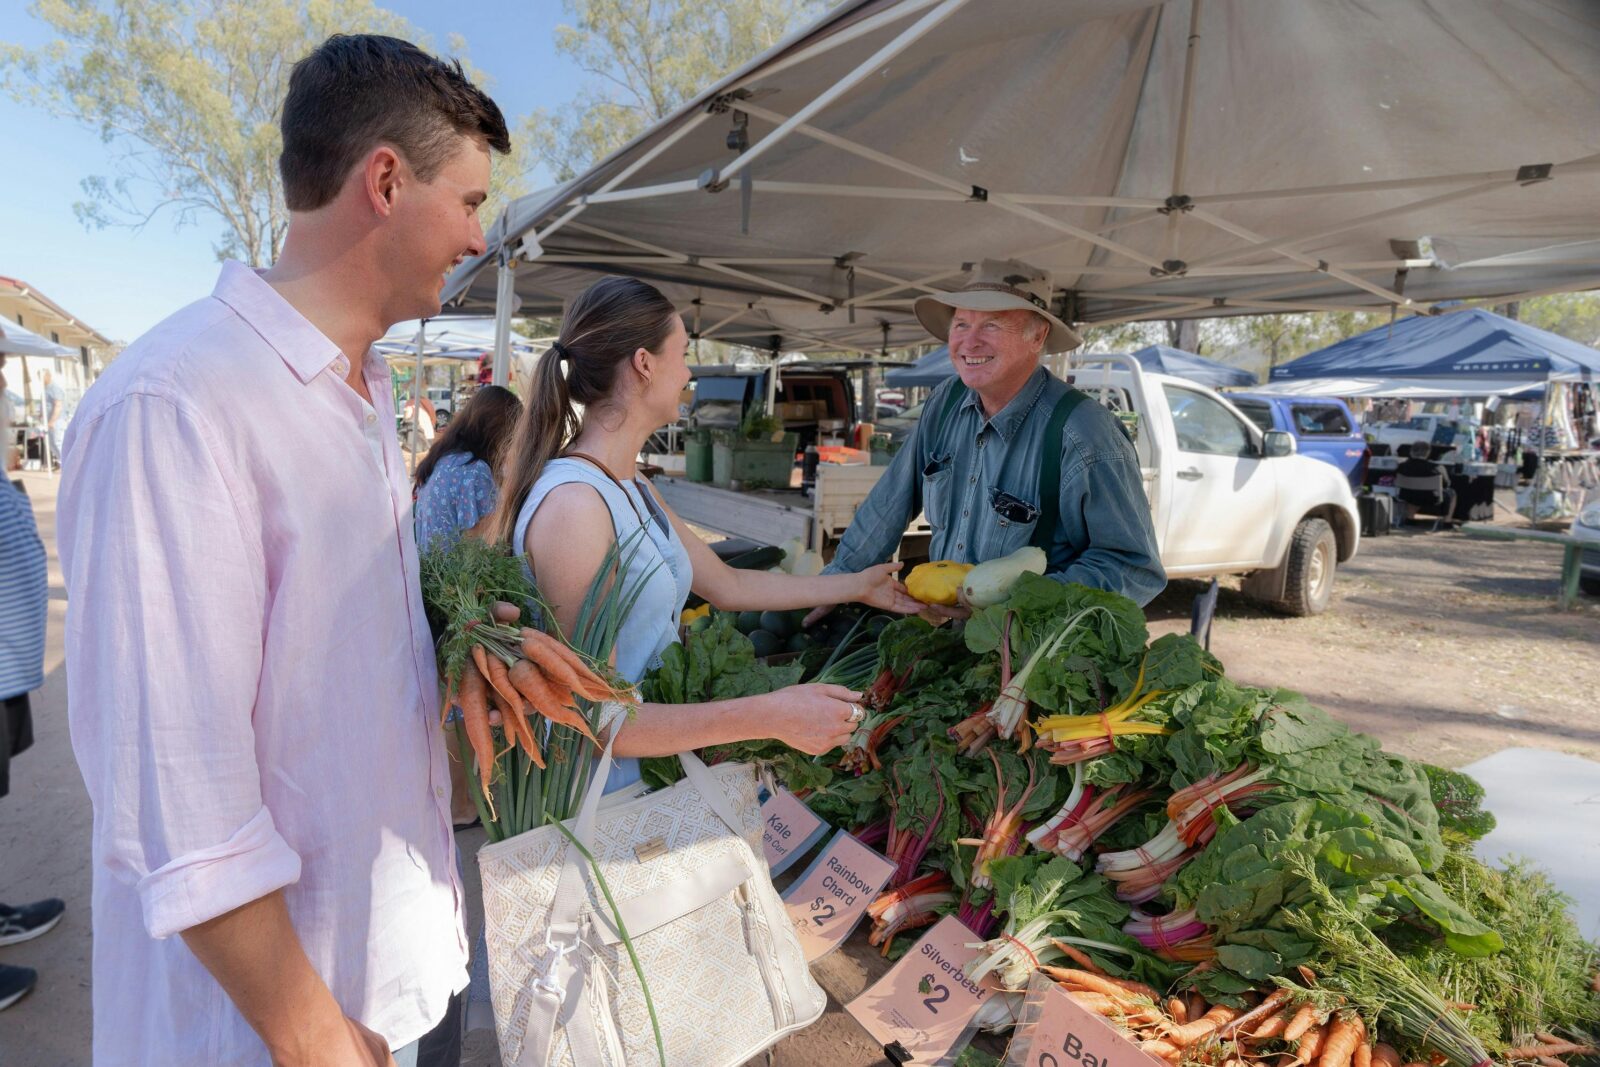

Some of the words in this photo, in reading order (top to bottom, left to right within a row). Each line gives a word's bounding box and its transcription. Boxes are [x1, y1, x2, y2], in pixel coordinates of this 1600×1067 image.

[767, 813, 791, 839] Kale
[822, 876, 857, 906] Chard
[826, 856, 873, 895] Rainbow
[810, 896, 836, 927] $2
[921, 943, 986, 1000] Silverbeet
